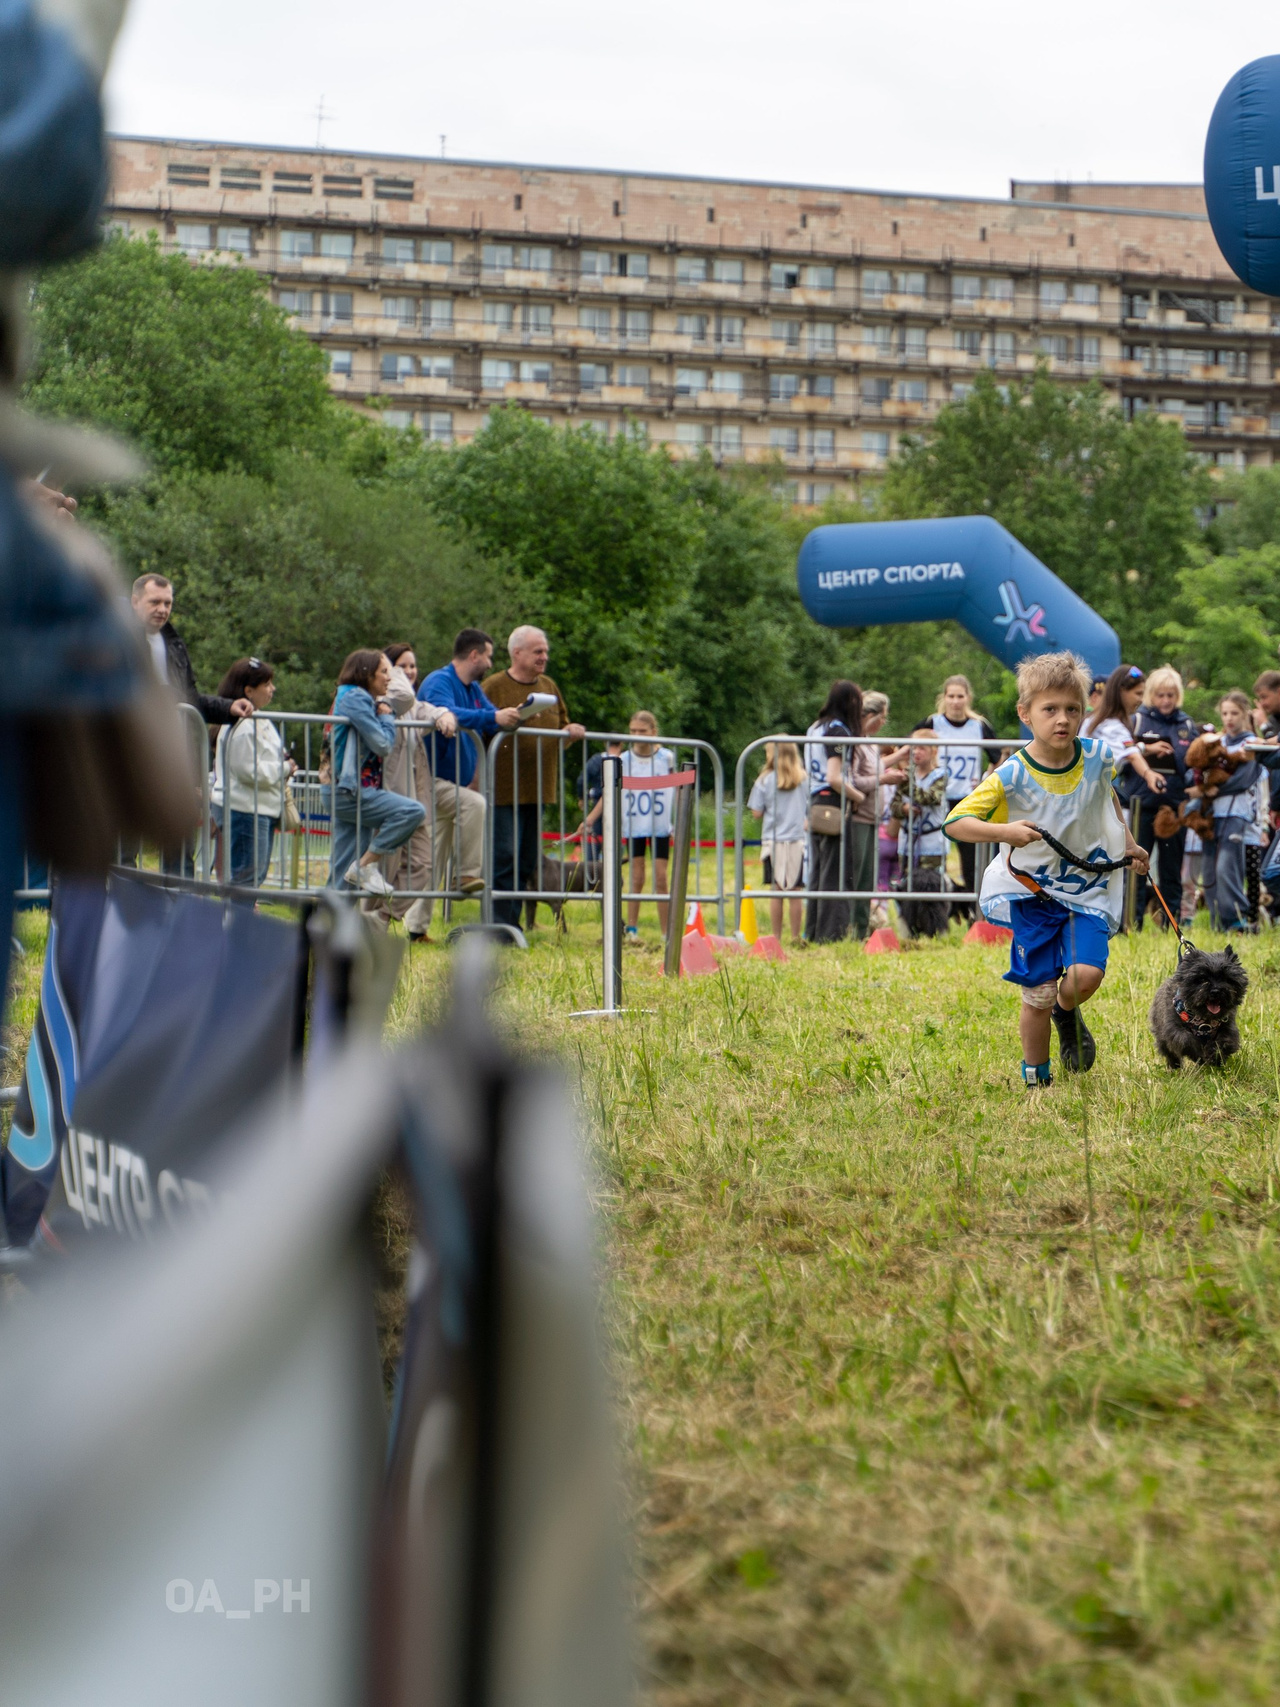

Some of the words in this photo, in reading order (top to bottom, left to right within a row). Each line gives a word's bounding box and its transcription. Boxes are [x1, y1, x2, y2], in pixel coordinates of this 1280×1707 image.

[818, 568, 881, 591] ЦЕНТР
[883, 561, 965, 585] СПОРТА
[625, 791, 664, 817] 205
[61, 1127, 151, 1242] ЦЕНТР
